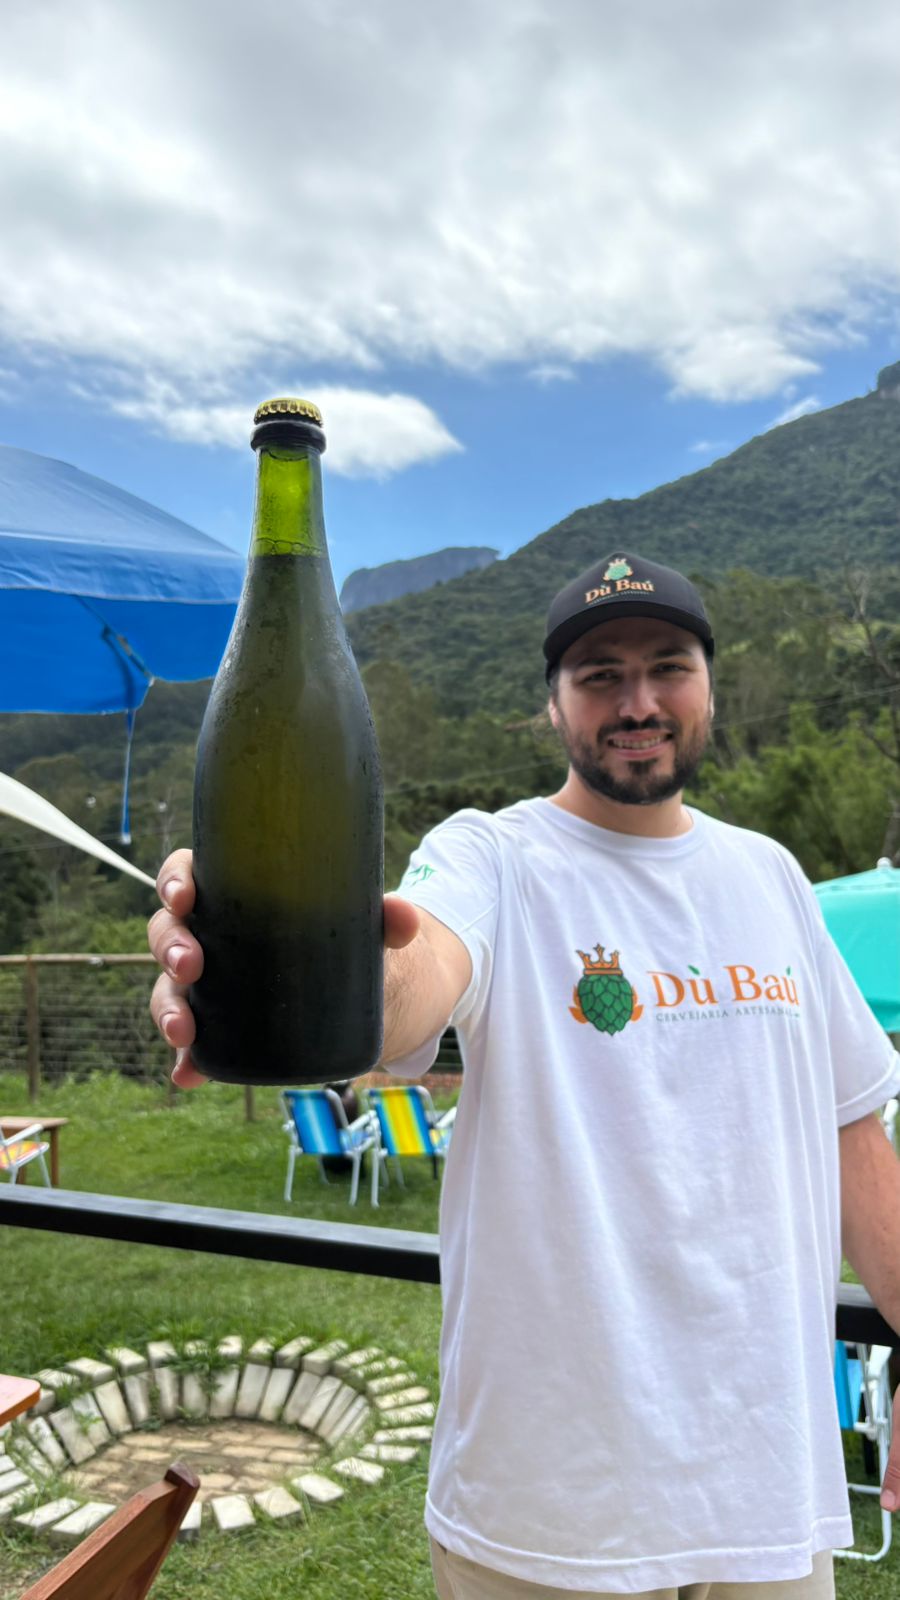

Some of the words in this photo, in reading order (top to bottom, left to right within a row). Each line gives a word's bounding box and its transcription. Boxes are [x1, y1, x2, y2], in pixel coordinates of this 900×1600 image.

[616, 579, 655, 592] Baú
[646, 964, 718, 1007] Dù
[723, 964, 799, 1006] Baú
[656, 1010, 729, 1022] CERVEJARIA
